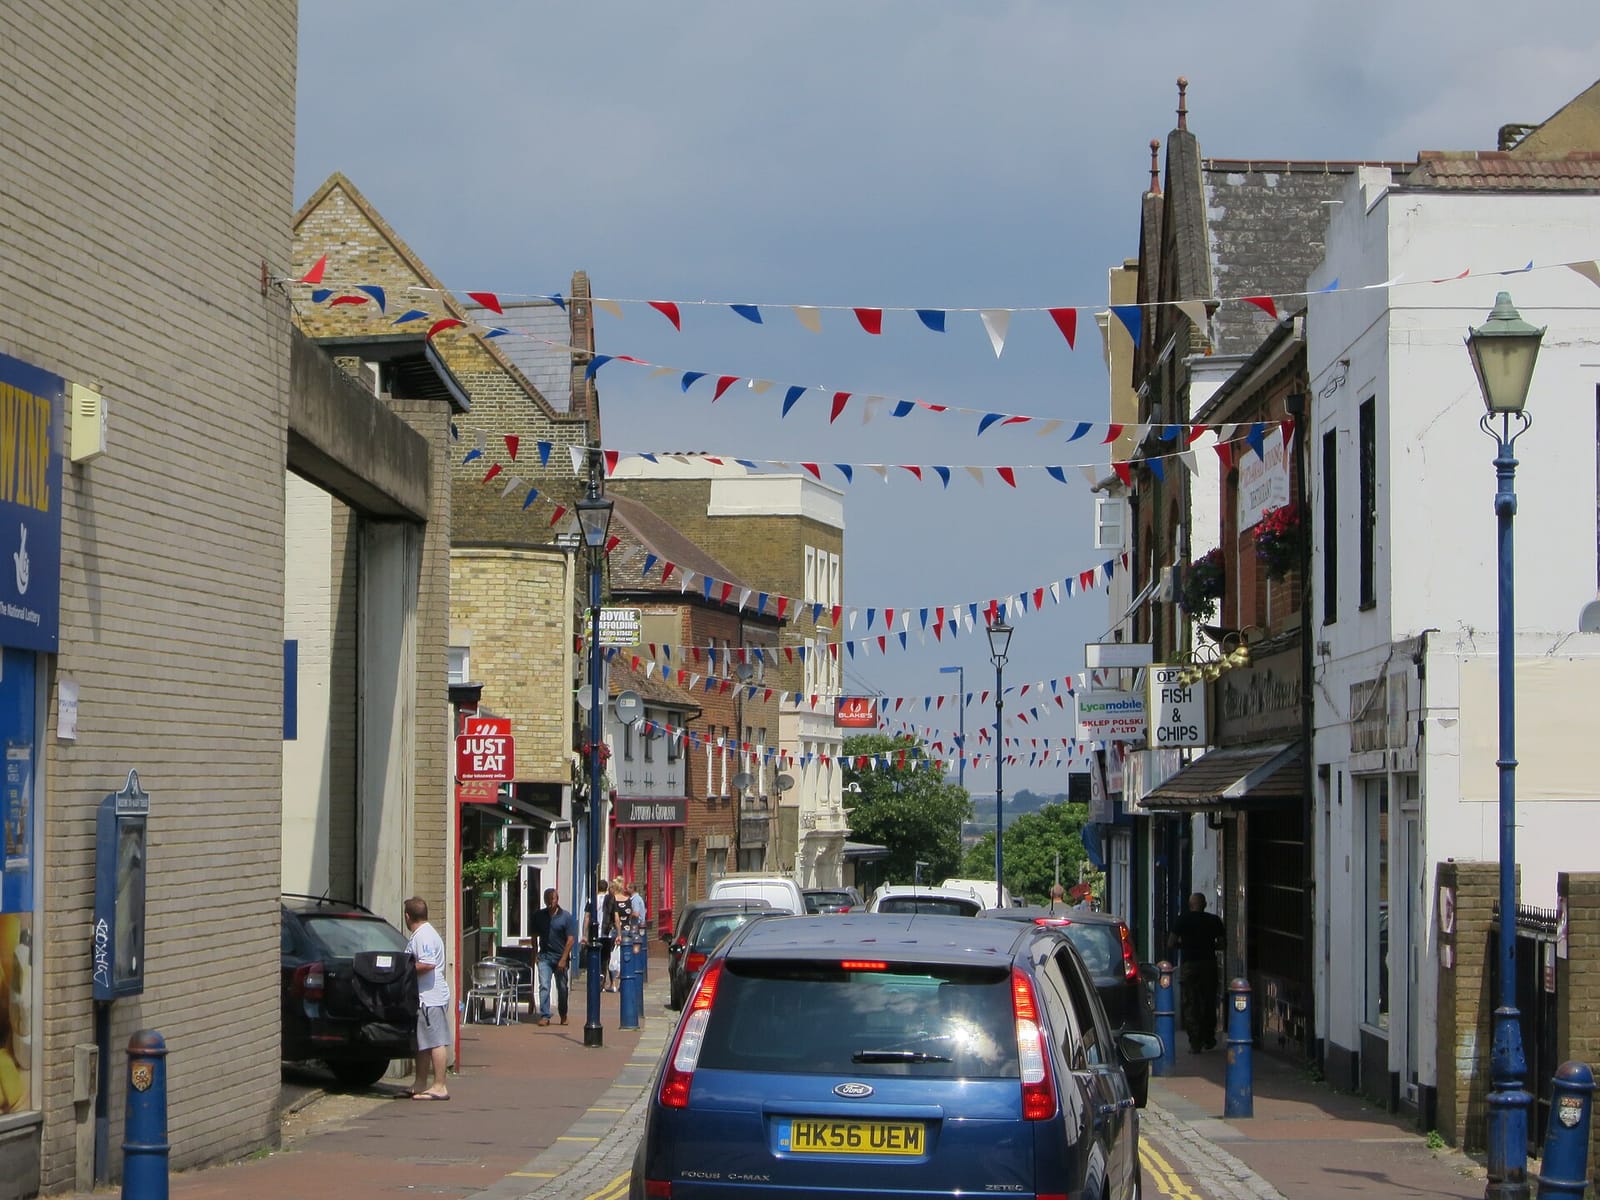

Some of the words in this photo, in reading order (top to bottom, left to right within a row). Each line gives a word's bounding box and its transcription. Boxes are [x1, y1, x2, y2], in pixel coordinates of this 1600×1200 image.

[25, 607, 40, 627] Lottery
[600, 611, 635, 621] ROYALE
[588, 621, 639, 630] SAFFOLDING
[1161, 688, 1192, 704] FISH
[1080, 700, 1142, 712] Lycamobile
[1112, 718, 1144, 726] POLSKI
[1172, 707, 1181, 723] &
[1157, 725, 1198, 742] CHIPS
[463, 738, 506, 755] JUST
[473, 755, 506, 771] EAT
[842, 1084, 864, 1095] Ford
[795, 1123, 862, 1147] HK56
[869, 1126, 919, 1149] UEM
[681, 1170, 721, 1179] FOCUS
[727, 1173, 770, 1181] C-MAX
